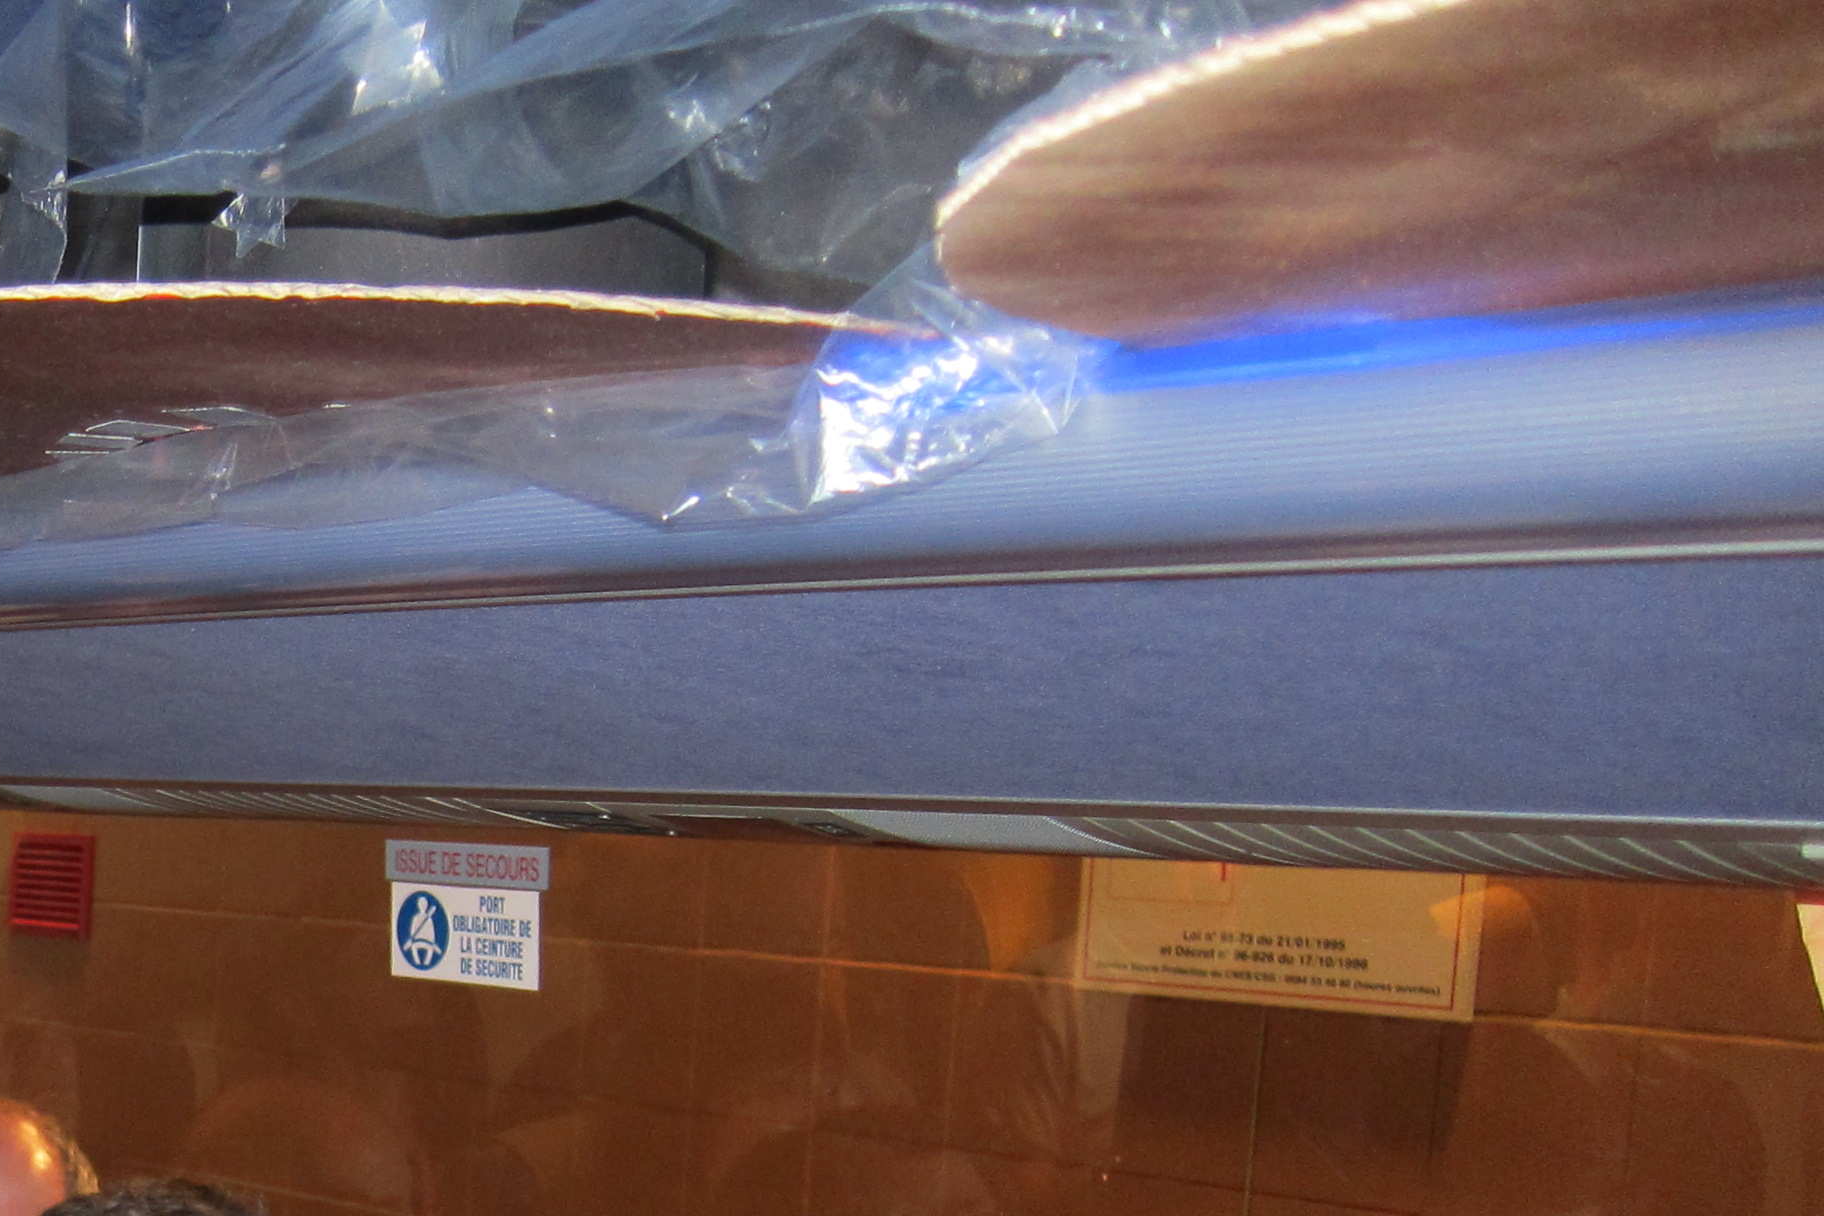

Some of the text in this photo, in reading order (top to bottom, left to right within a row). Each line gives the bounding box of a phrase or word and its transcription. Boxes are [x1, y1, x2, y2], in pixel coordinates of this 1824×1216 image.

[395, 849, 540, 882] ISSUE DE SECOURS
[479, 895, 505, 914] PORT
[453, 915, 532, 938] OBLIGATOIRE DE
[460, 937, 523, 959] LA CEINTURE
[460, 957, 523, 981] DE SECURITE
